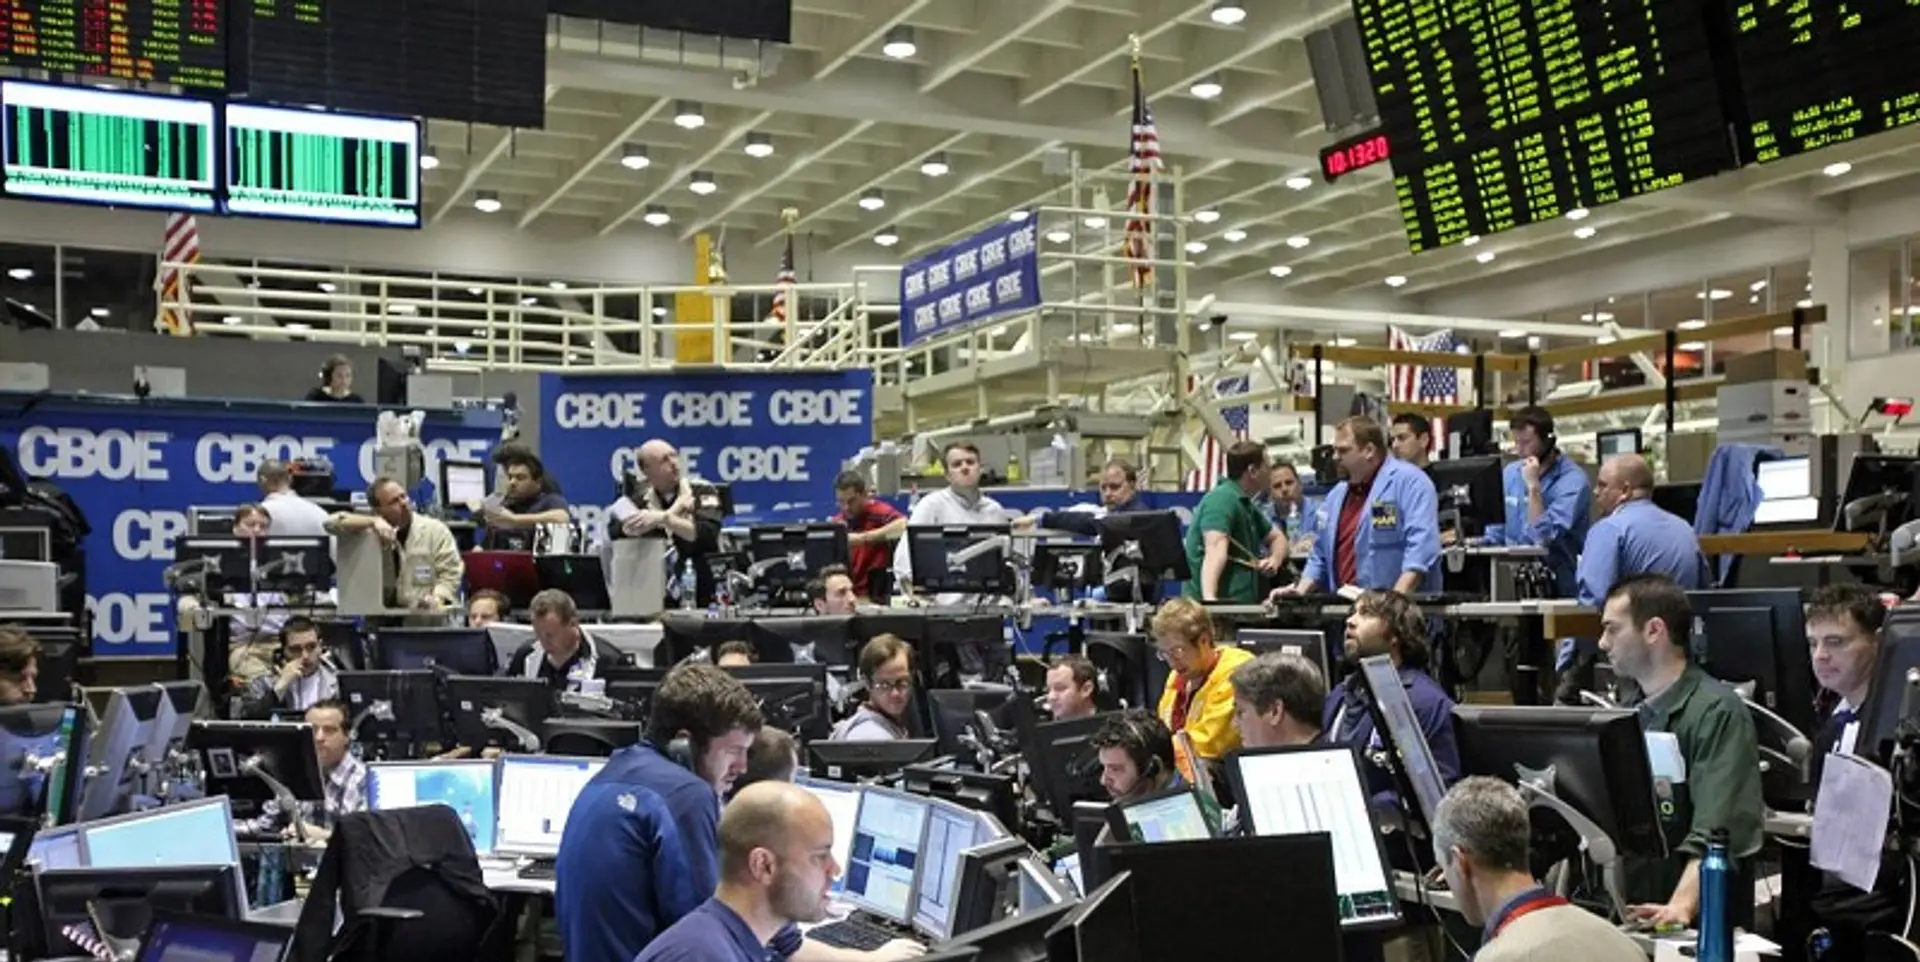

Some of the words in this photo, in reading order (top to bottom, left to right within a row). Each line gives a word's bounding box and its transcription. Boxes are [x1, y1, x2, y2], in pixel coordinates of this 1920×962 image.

[904, 270, 926, 298] CBOE
[928, 260, 951, 290] CBOE
[954, 248, 979, 279] CBOE
[981, 235, 1006, 269] CBOE
[1008, 224, 1035, 258] CBOE
[914, 302, 937, 330] CBOE
[938, 292, 962, 321] CBOE
[965, 281, 992, 313] CBOE
[995, 269, 1022, 301] CBOE
[555, 392, 646, 428] CBOE
[661, 391, 753, 427] CBOE
[768, 388, 864, 425] CBOE
[18, 425, 169, 480] CBOE
[611, 447, 703, 483] CE
[717, 446, 811, 481] CBOE
[113, 508, 188, 560] CB
[85, 592, 170, 643] OE
